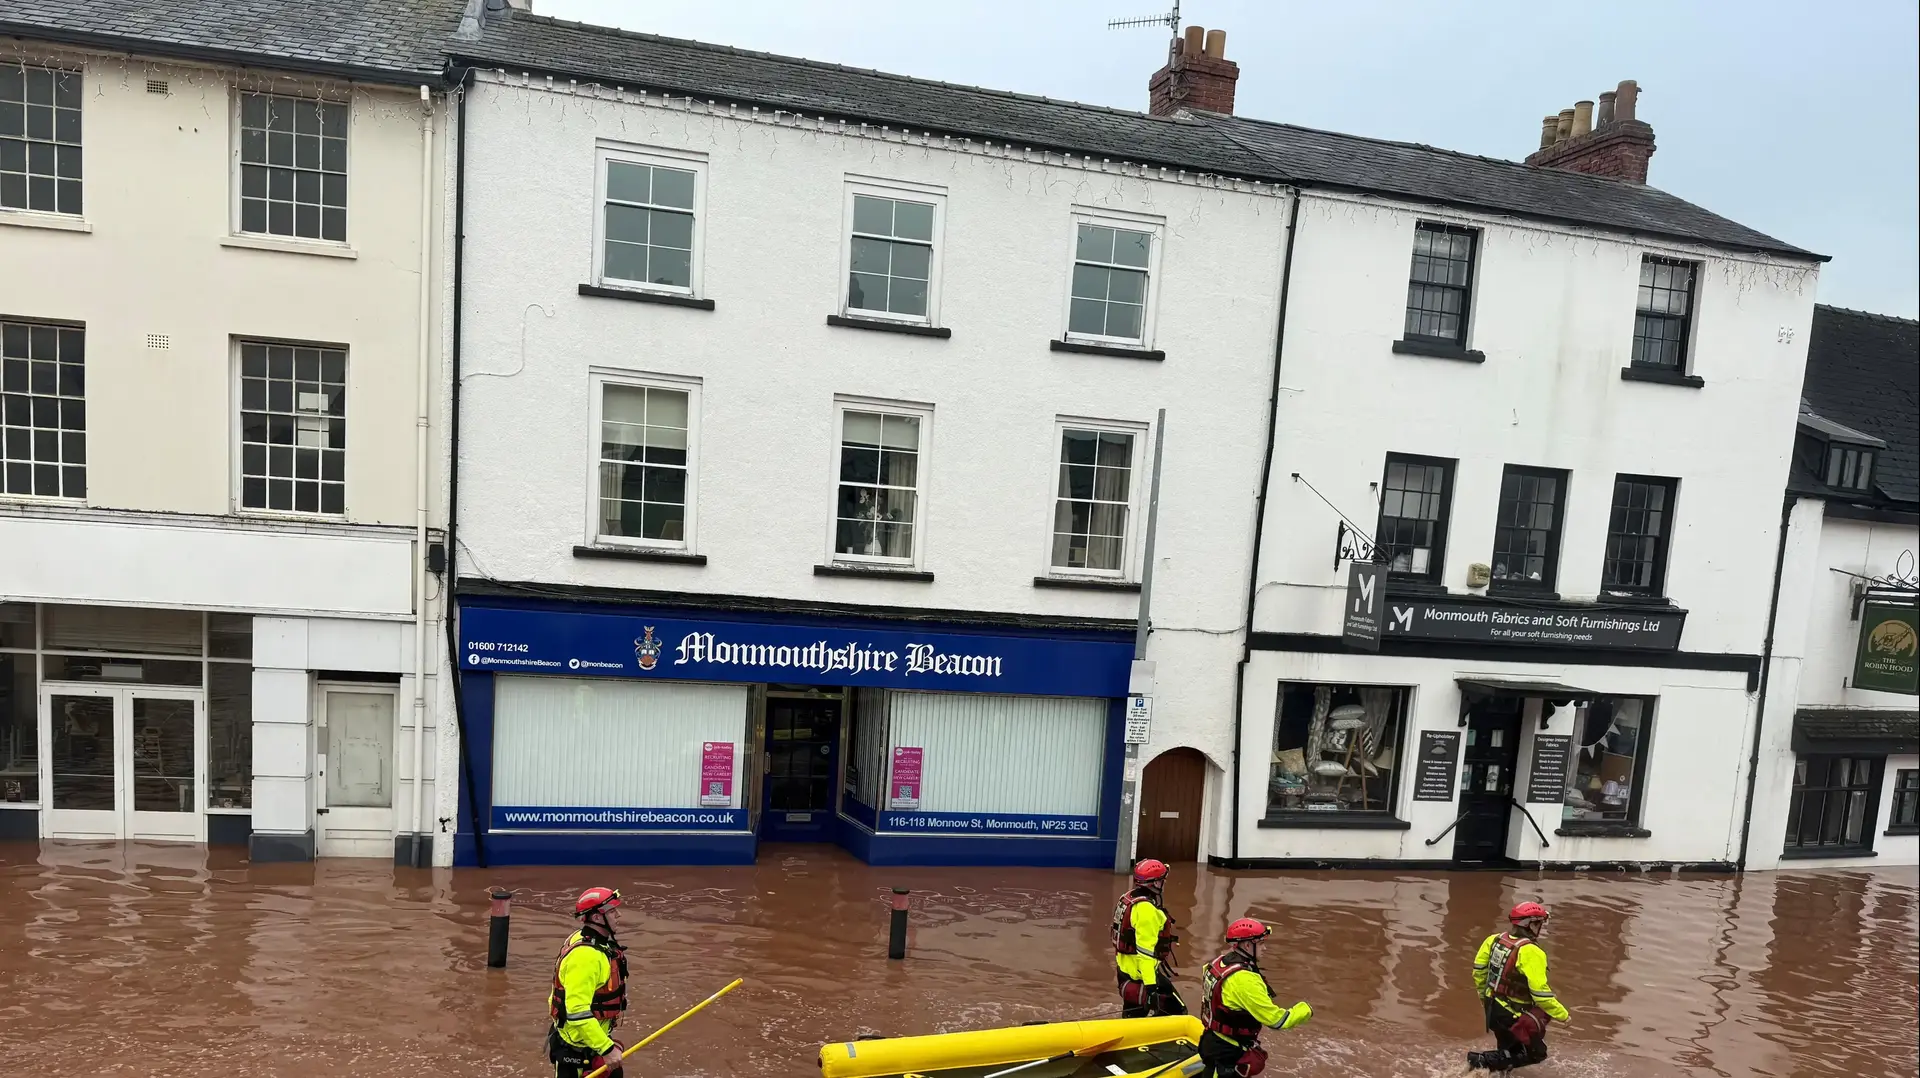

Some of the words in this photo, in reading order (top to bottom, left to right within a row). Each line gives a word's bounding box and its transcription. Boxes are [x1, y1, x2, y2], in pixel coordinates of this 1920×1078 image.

[1424, 608, 1489, 623] Monmouth
[1491, 611, 1530, 626] Fabrics
[1531, 613, 1553, 626] and
[1555, 613, 1578, 628] Soft
[1580, 616, 1640, 633] Furnishings
[1642, 620, 1660, 632] Ltd
[1490, 628, 1502, 636] For
[1511, 631, 1526, 639] your
[1527, 630, 1540, 638] soft
[1540, 631, 1573, 642] furnishing
[1573, 633, 1593, 641] needs
[468, 641, 495, 650] 01600
[497, 643, 529, 652] 712142
[674, 631, 899, 676] Monmouthshire
[904, 643, 1003, 677] Beacon
[481, 656, 561, 667] @MonmouthshireBeacon
[580, 661, 624, 669] @monbeacon
[1864, 662, 1888, 670] ROBIN
[1889, 664, 1913, 673] HOOD
[504, 810, 734, 824] www.monmouthshirebeacon.co.uk
[888, 816, 925, 827] 116-118
[927, 817, 970, 828] Monnow
[970, 818, 984, 829] St,
[986, 818, 1039, 830] Monmouth,
[1041, 820, 1067, 830] NP25
[1068, 821, 1088, 831] 3EQ
